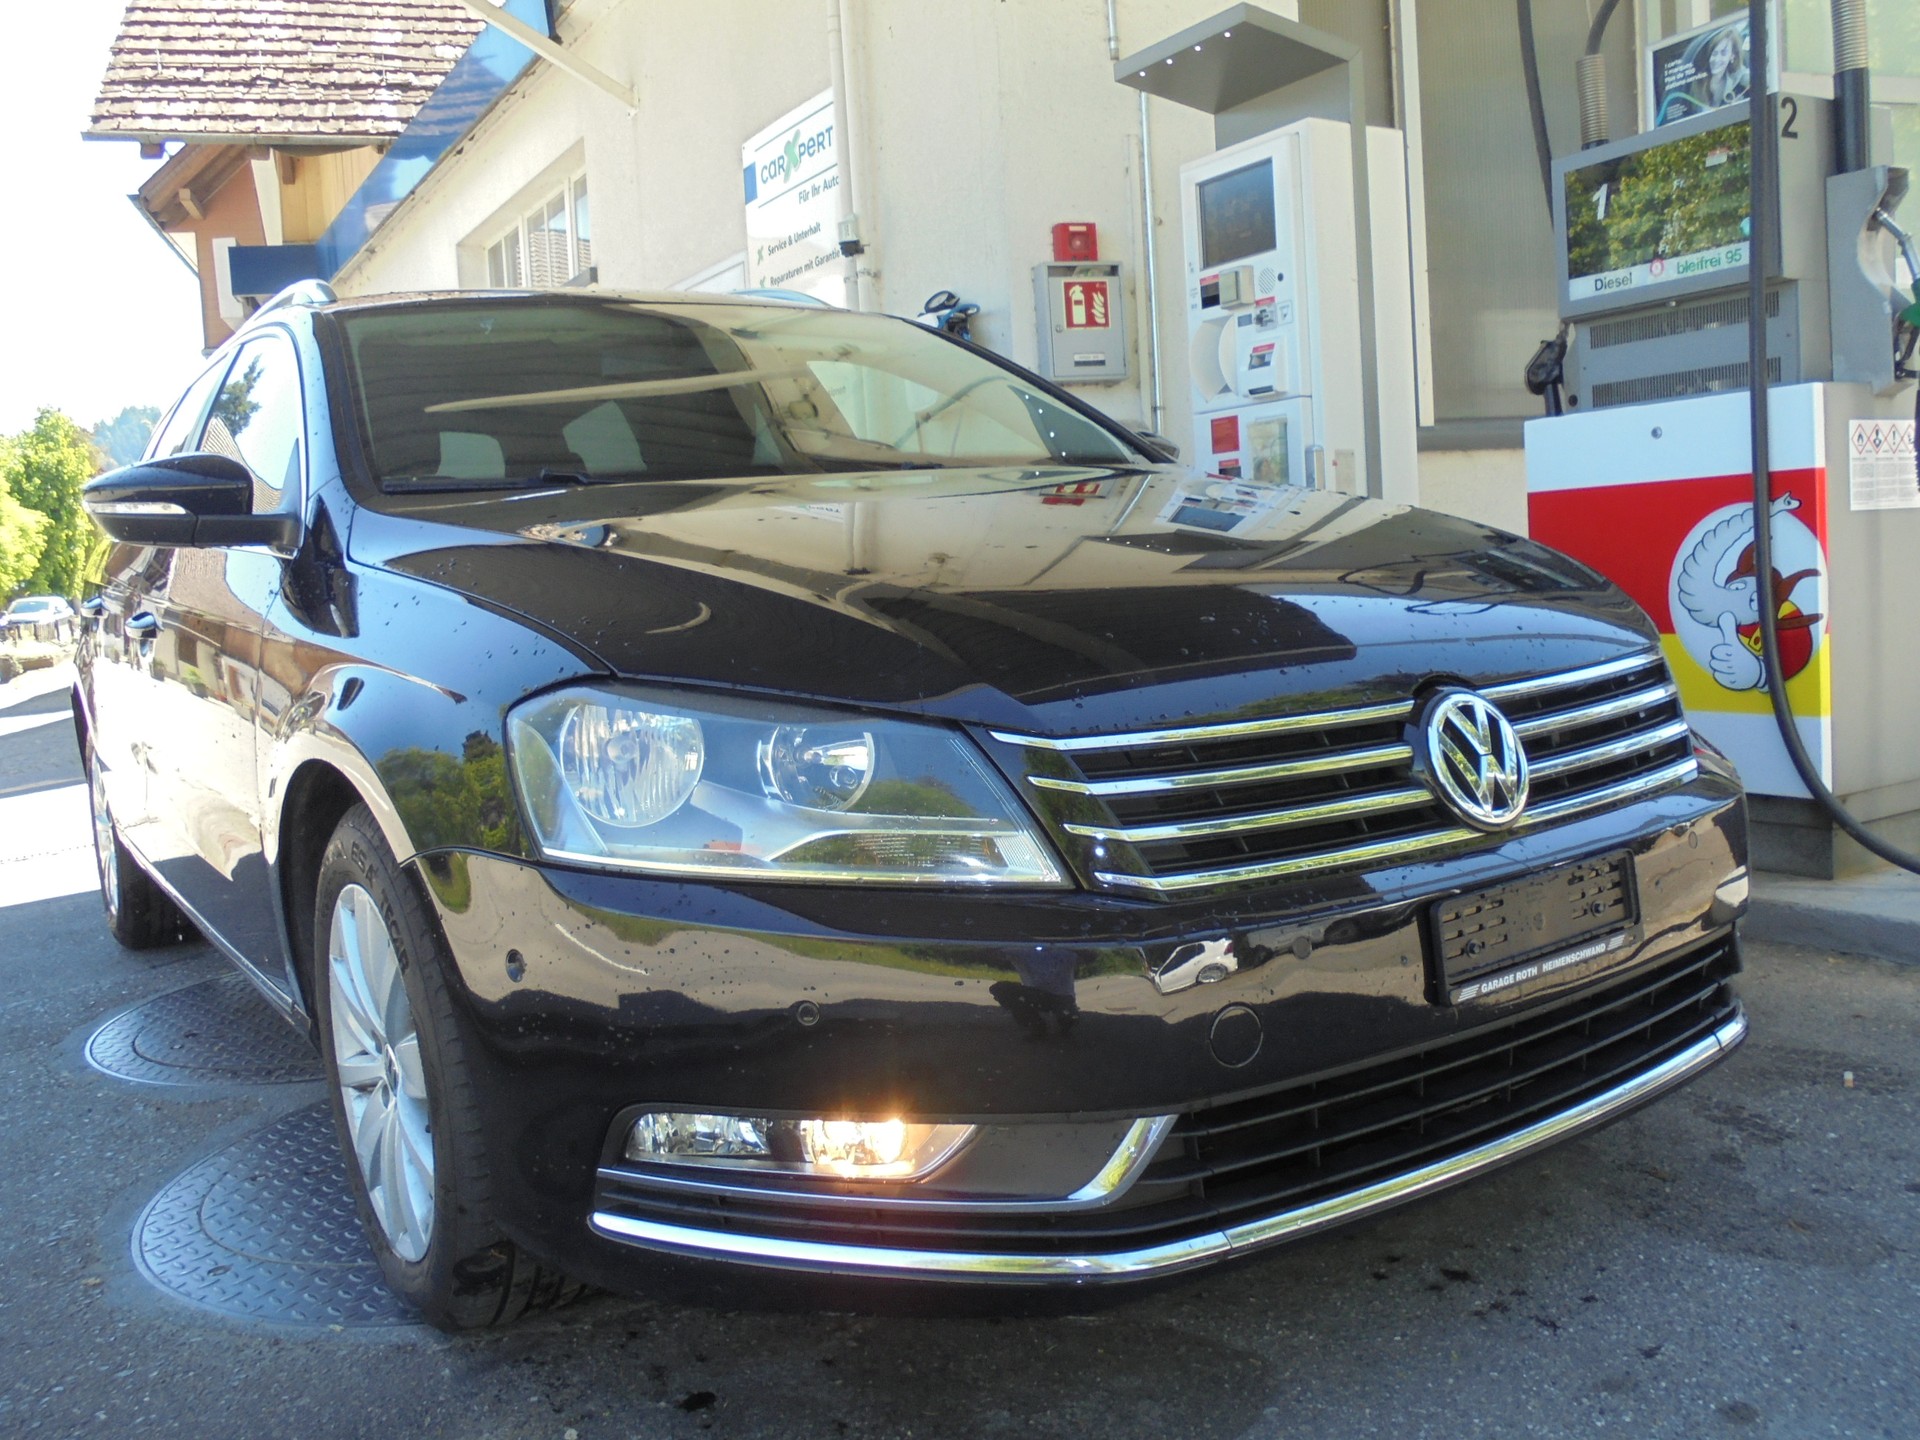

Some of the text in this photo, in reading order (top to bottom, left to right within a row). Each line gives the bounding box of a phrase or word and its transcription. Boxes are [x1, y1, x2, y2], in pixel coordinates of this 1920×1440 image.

[1780, 97, 1798, 139] 2
[798, 189, 810, 205] Für
[811, 183, 821, 198] Ihr
[1592, 183, 1609, 221] 1
[768, 222, 821, 257] Service & Unterhalt
[770, 247, 840, 287] Reparaturen mit Garantie
[1594, 248, 1743, 291] Diesel bleifrei 95
[1480, 942, 1607, 994] GARAGE ROTH HEIMENSCHWAND
